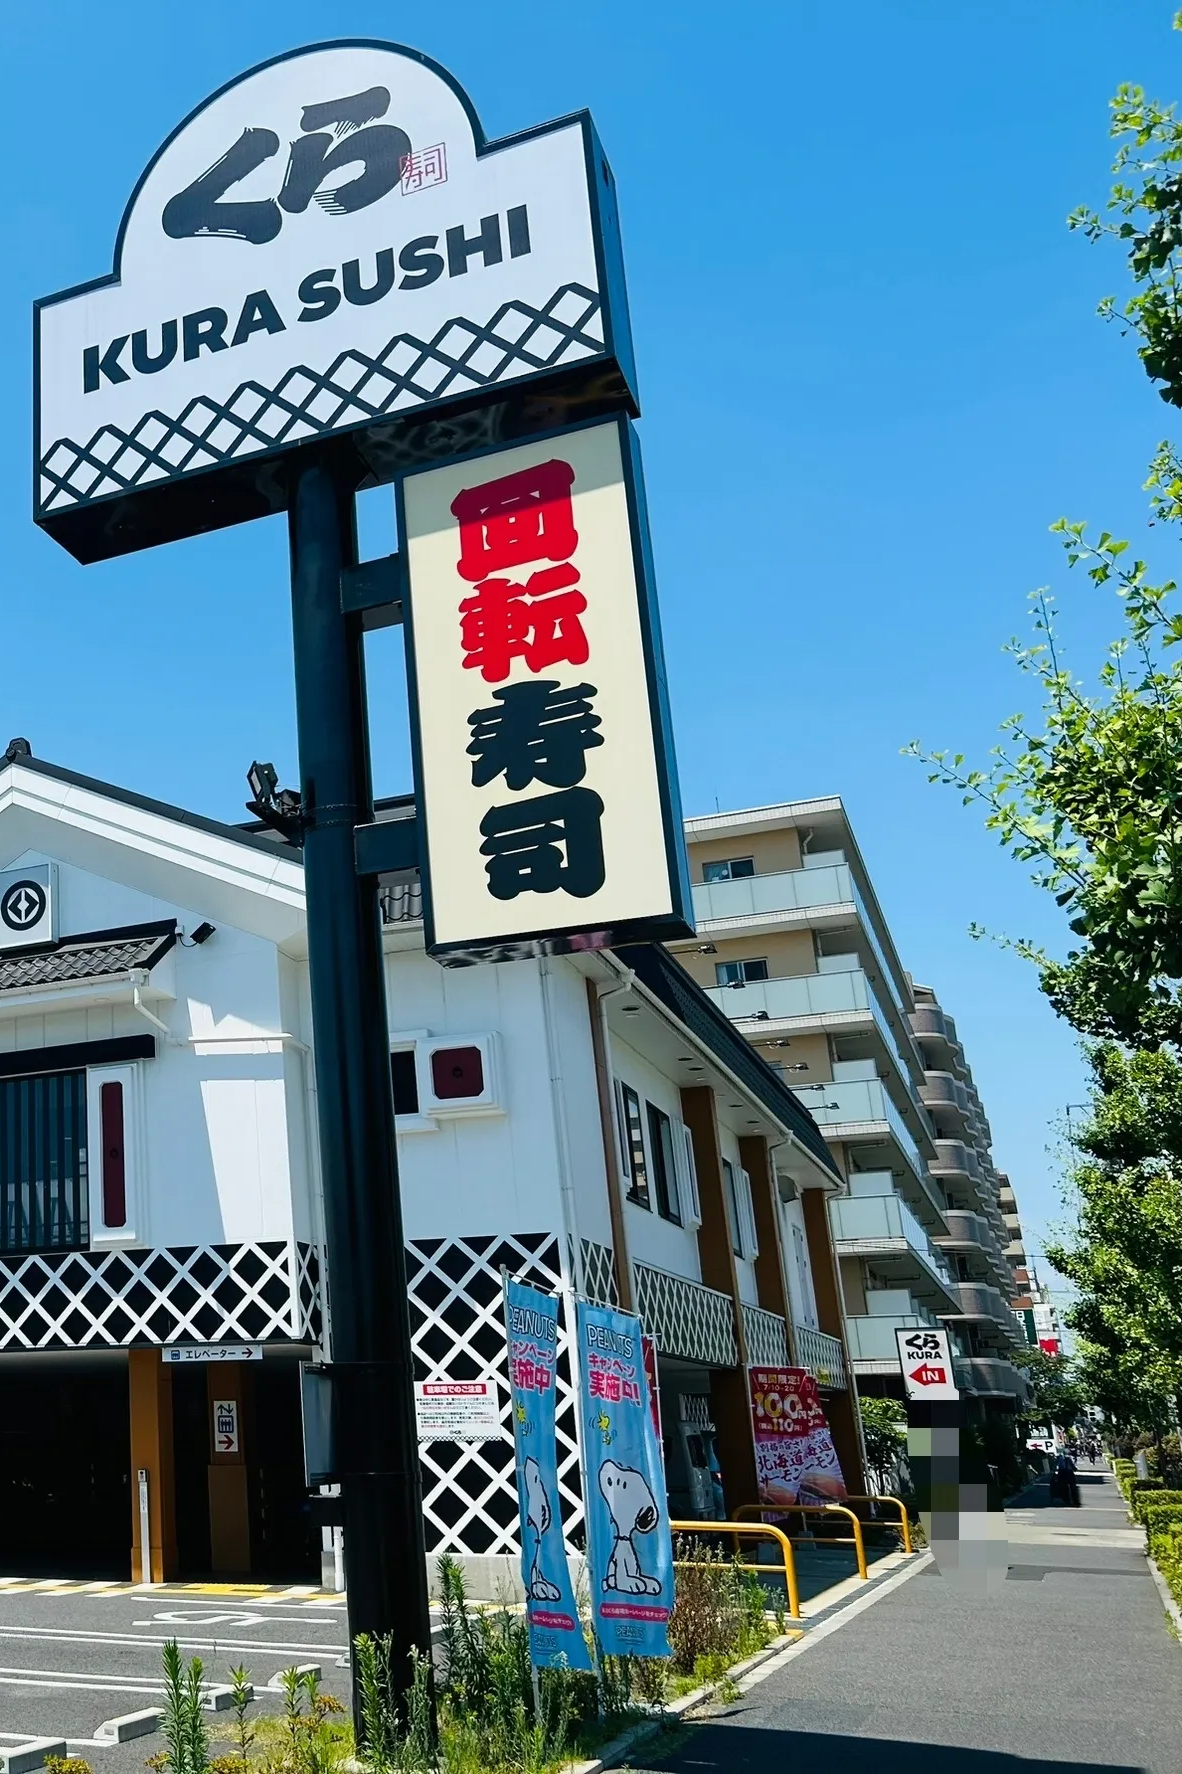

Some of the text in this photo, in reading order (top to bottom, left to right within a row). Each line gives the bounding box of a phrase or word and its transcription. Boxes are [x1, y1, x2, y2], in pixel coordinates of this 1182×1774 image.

[162, 86, 413, 244] くら
[83, 204, 531, 394] KURA SUSHI
[450, 459, 606, 900] 回転寿司
[512, 1340, 555, 1364] ャンペーン
[905, 1333, 940, 1351] くら
[185, 1349, 236, 1359] エレベーター
[907, 1351, 942, 1360] KURA
[921, 1370, 939, 1381] IN
[754, 1391, 807, 1419] 100円
[1044, 1441, 1053, 1451] P
[758, 1450, 805, 1474] 北海道
[759, 1468, 803, 1488] サーモン
